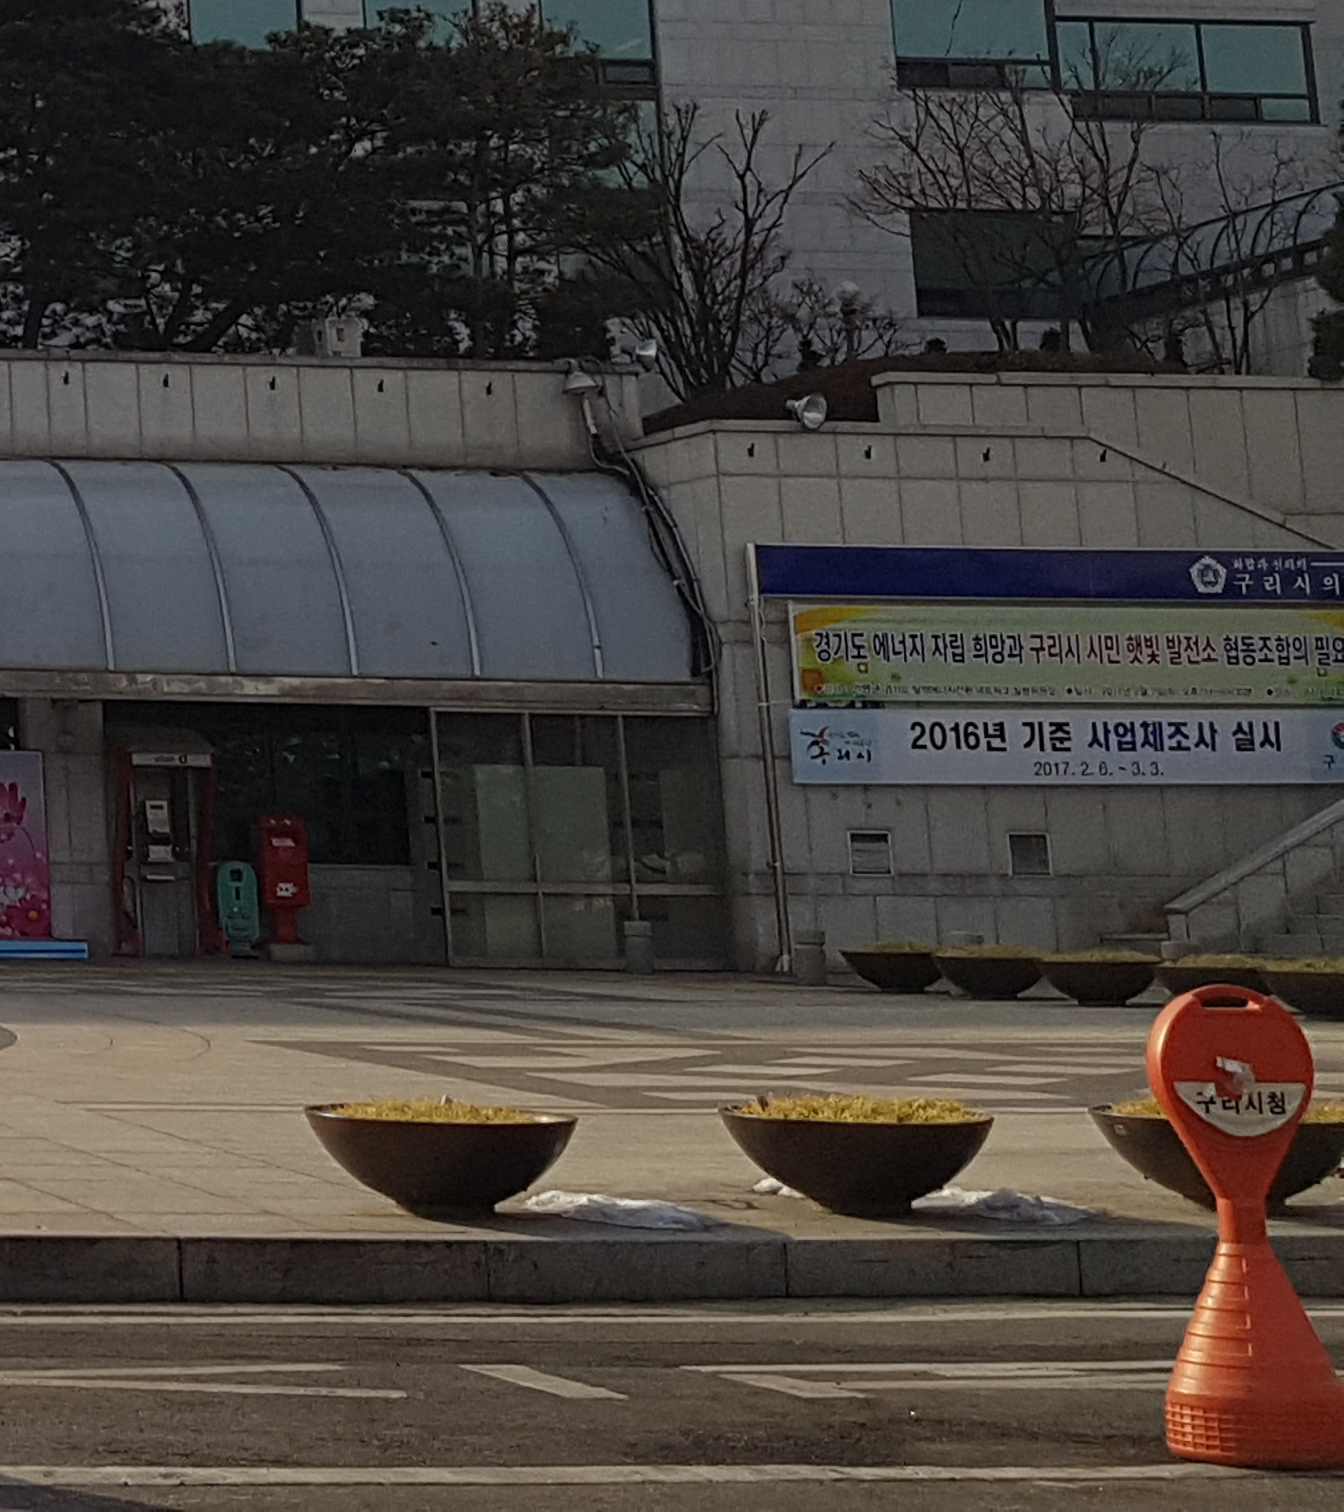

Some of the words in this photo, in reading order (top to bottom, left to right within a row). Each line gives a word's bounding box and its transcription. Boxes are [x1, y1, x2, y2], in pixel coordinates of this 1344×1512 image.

[814, 631, 868, 664] 경기도
[873, 632, 925, 663] 에너지
[932, 632, 966, 663] 자립
[972, 632, 1024, 664] 희망과
[1029, 633, 1081, 664] 구리시
[1087, 634, 1121, 665] 시민
[1126, 634, 1160, 665] 햇빛
[1166, 634, 1218, 665] 발전소
[1223, 634, 1309, 666] 협동조합의
[910, 721, 1007, 752] 2016년
[1023, 721, 1072, 752] 기준
[1087, 721, 1217, 753] 사업체조사
[1232, 721, 1282, 752] 실시
[1033, 761, 1075, 776] 2017.
[1131, 762, 1146, 777] 3.
[1150, 762, 1165, 778] 3.
